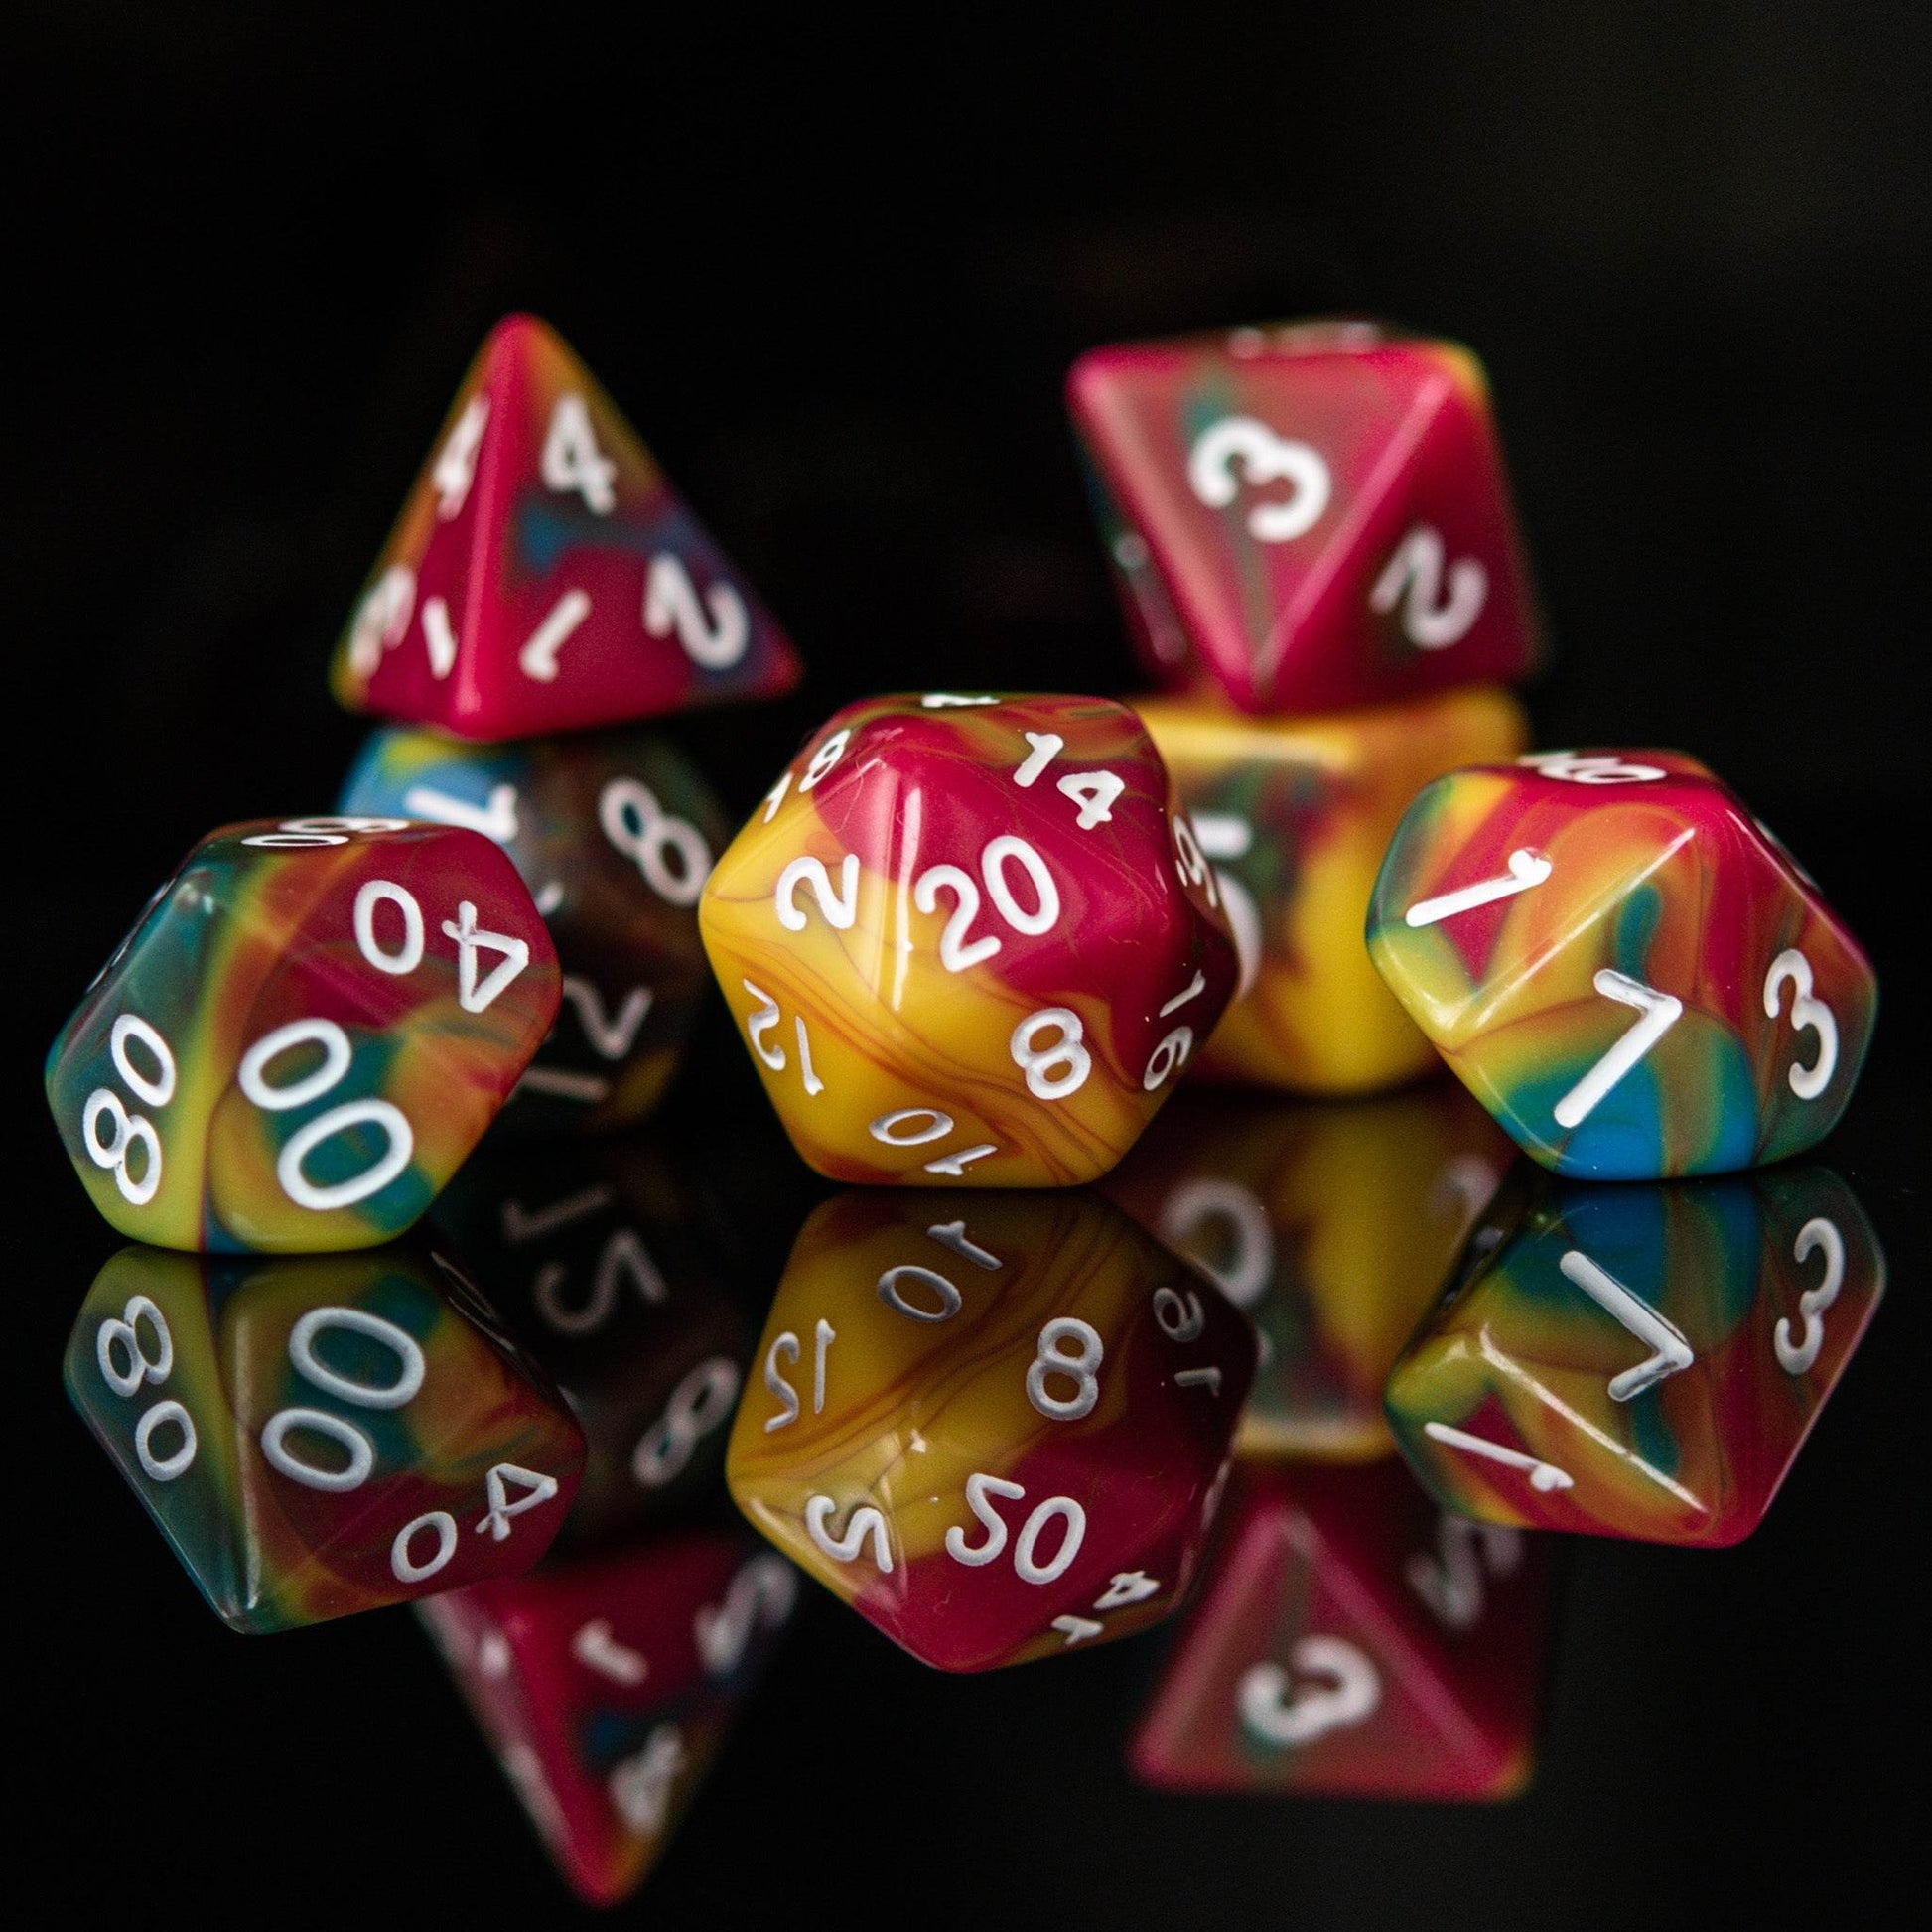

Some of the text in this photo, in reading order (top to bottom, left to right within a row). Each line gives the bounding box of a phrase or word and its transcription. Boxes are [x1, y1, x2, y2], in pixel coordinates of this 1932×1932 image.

[542, 394, 618, 513] 4
[1194, 417, 1332, 543] 3
[643, 552, 750, 668] 2
[1370, 524, 1488, 649] 2
[763, 729, 851, 824] 18
[1013, 732, 1125, 829] 14
[602, 778, 713, 907] 8
[775, 855, 860, 931] 2
[914, 835, 1060, 972] 20
[1406, 846, 1552, 927] 1
[354, 880, 530, 1013] 40
[743, 979, 824, 1095] 12
[1011, 1008, 1091, 1100] 8
[1144, 969, 1205, 1091] 16
[1554, 968, 1683, 1127] 7
[1763, 948, 1839, 1100] 3
[82, 1014, 176, 1205] 80
[239, 1018, 414, 1210] 00
[870, 1109, 998, 1175] 10
